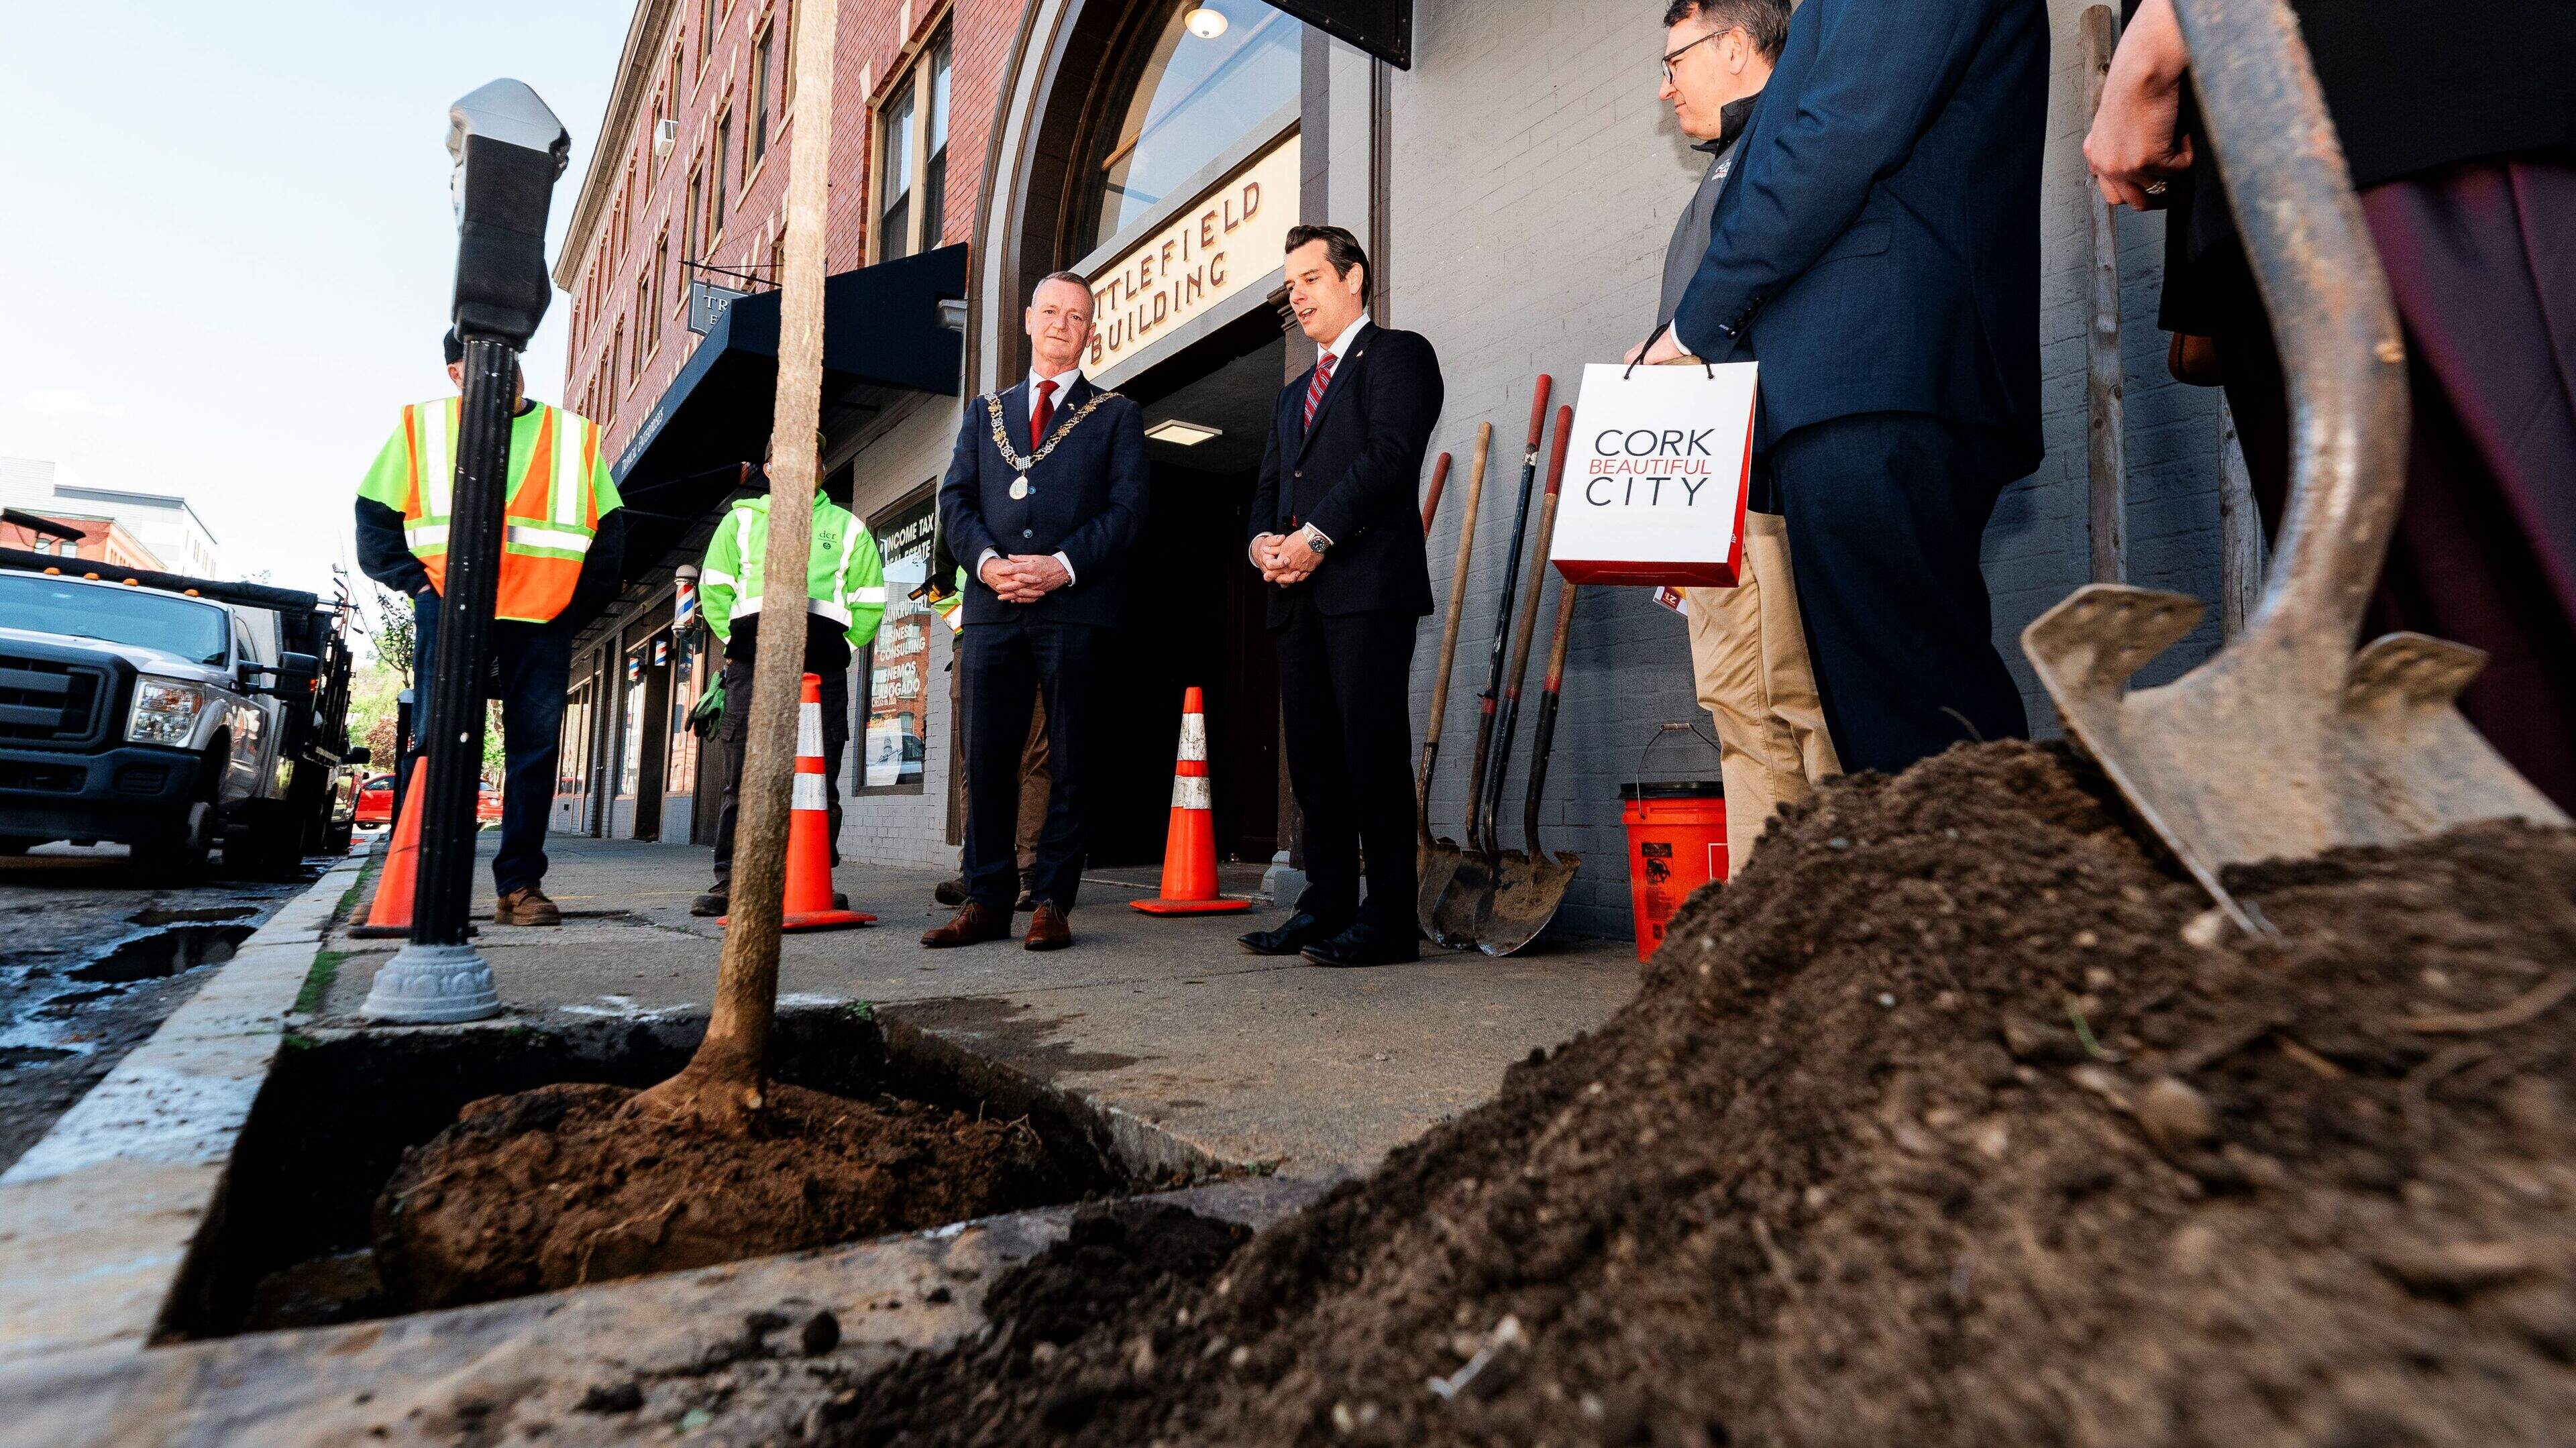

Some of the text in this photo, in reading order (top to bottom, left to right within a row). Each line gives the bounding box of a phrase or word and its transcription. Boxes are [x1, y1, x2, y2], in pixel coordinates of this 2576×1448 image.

[1091, 252, 1225, 364] BUILDING
[1595, 429, 1715, 456] CORK
[1589, 459, 1711, 474] BEAUTIFUL
[1586, 477, 1709, 506] CITY
[819, 530, 837, 539] dcr
[919, 512, 934, 537] TAX
[880, 636, 925, 661] CONSULTING
